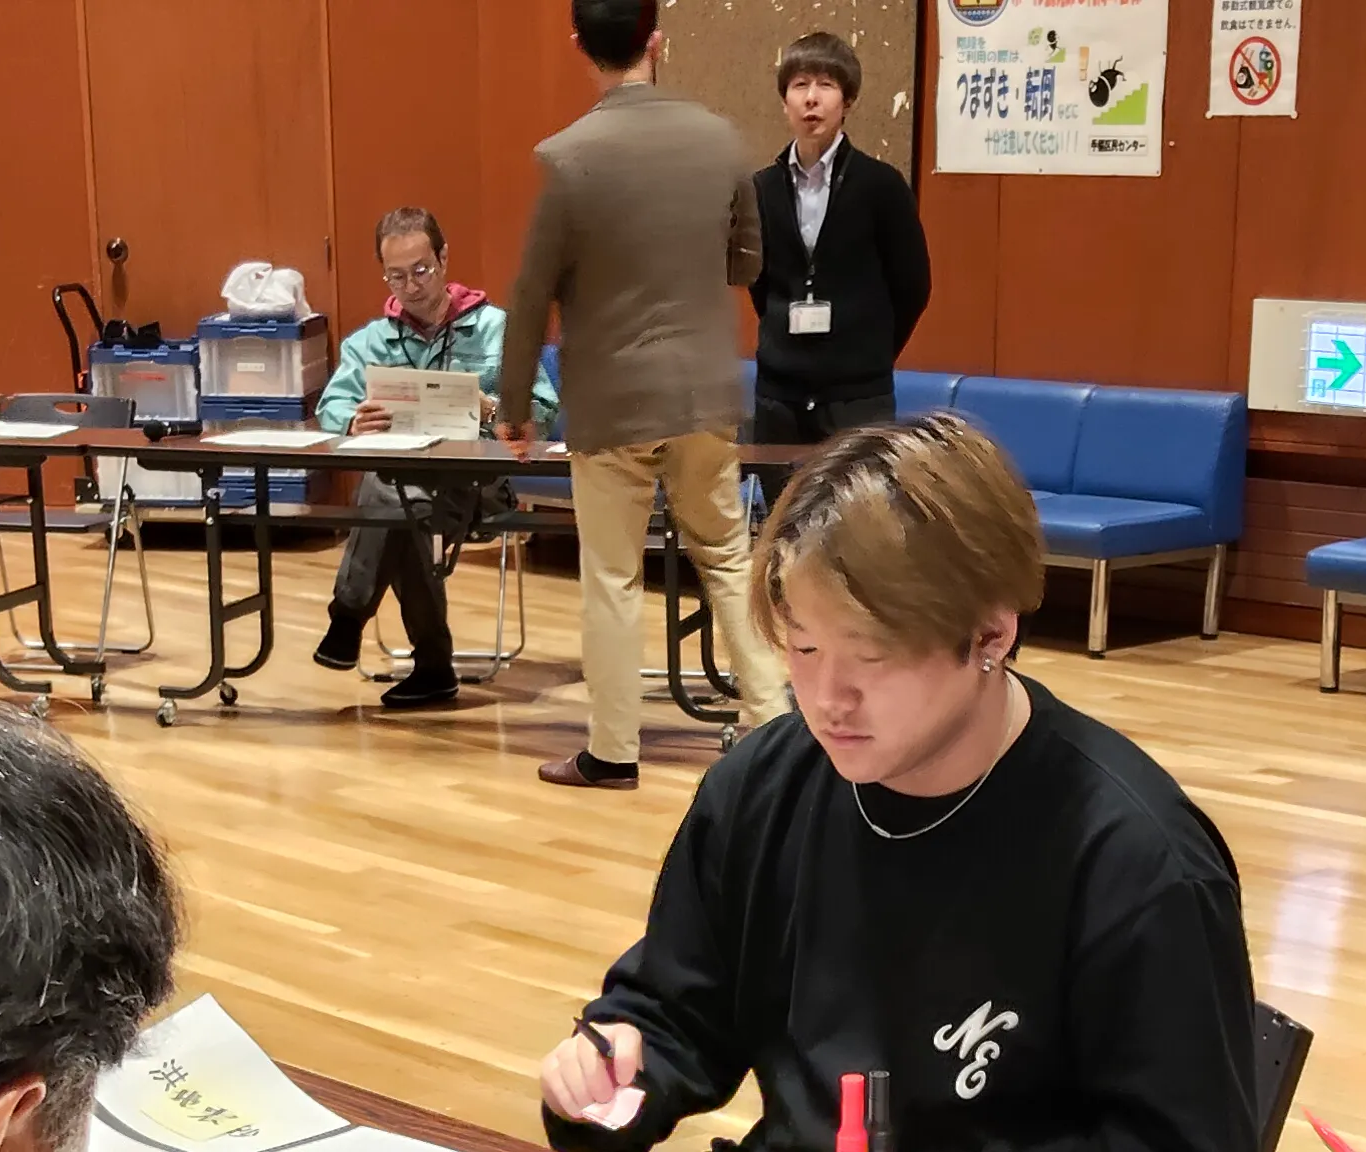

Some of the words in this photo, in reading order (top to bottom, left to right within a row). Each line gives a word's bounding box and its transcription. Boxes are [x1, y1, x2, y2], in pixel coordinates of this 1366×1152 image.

[956, 66, 1056, 122] つまずき・転倒
